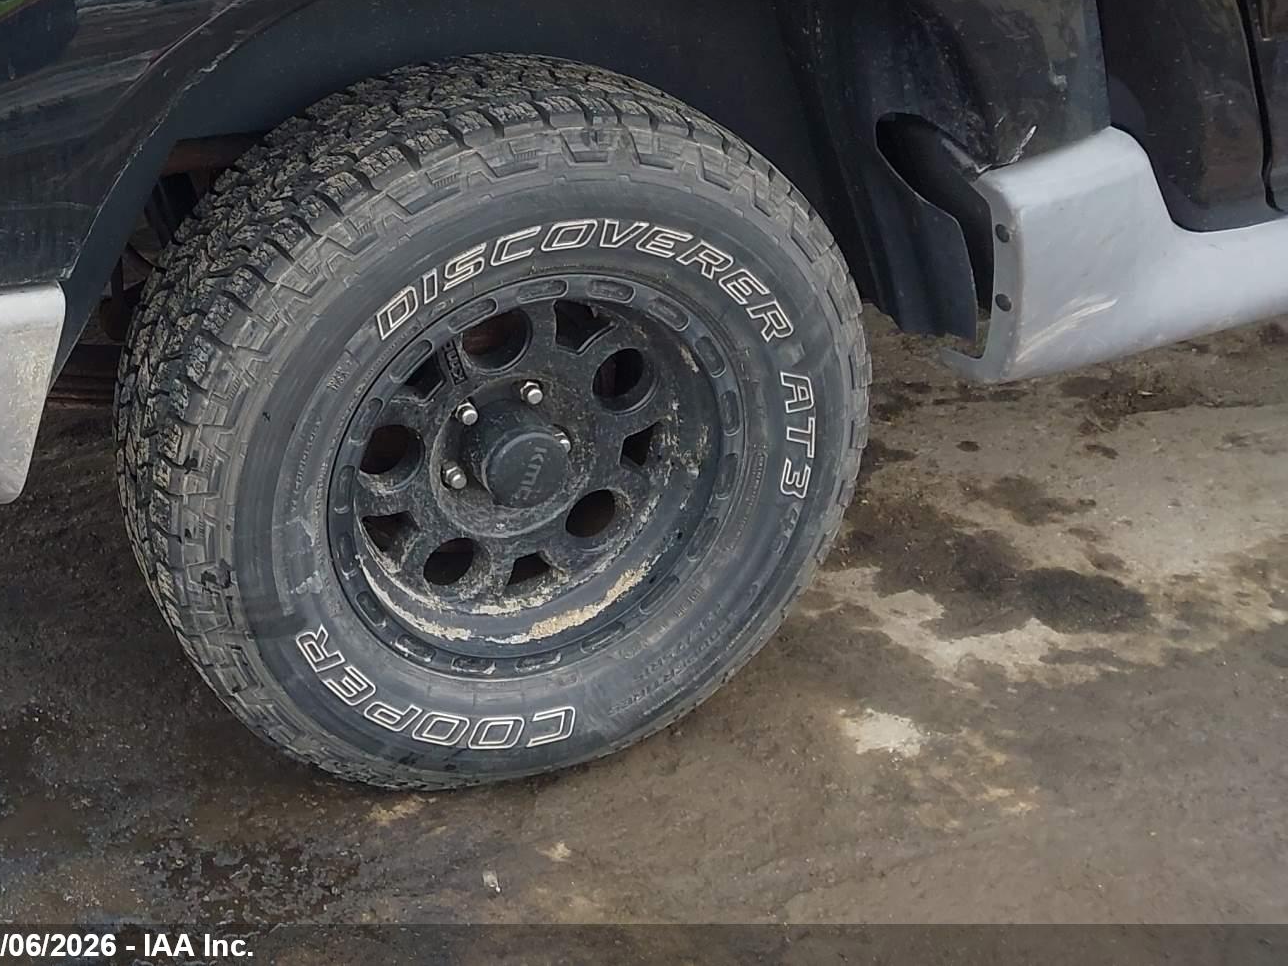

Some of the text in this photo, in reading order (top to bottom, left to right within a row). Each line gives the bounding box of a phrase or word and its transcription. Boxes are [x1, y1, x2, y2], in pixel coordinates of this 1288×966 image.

[374, 218, 795, 341] DISCOVERER
[778, 371, 818, 499] AT3
[295, 625, 576, 751] COOPER
